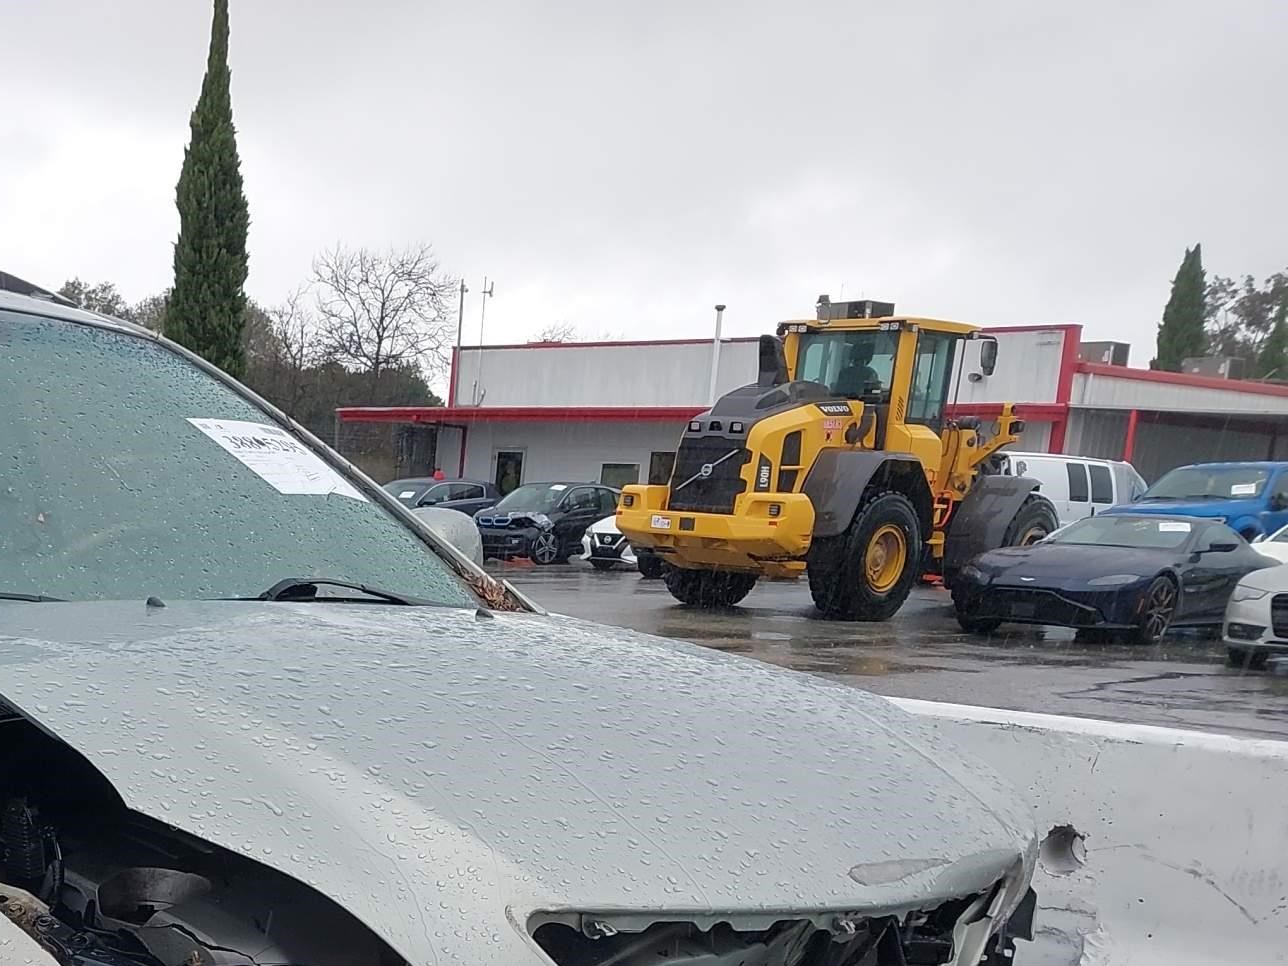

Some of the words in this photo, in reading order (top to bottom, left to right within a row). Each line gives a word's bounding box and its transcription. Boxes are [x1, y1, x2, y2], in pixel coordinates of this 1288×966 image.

[819, 405, 850, 413] VOLVO
[222, 436, 308, 456] 3885295
[759, 465, 771, 488] L90H
